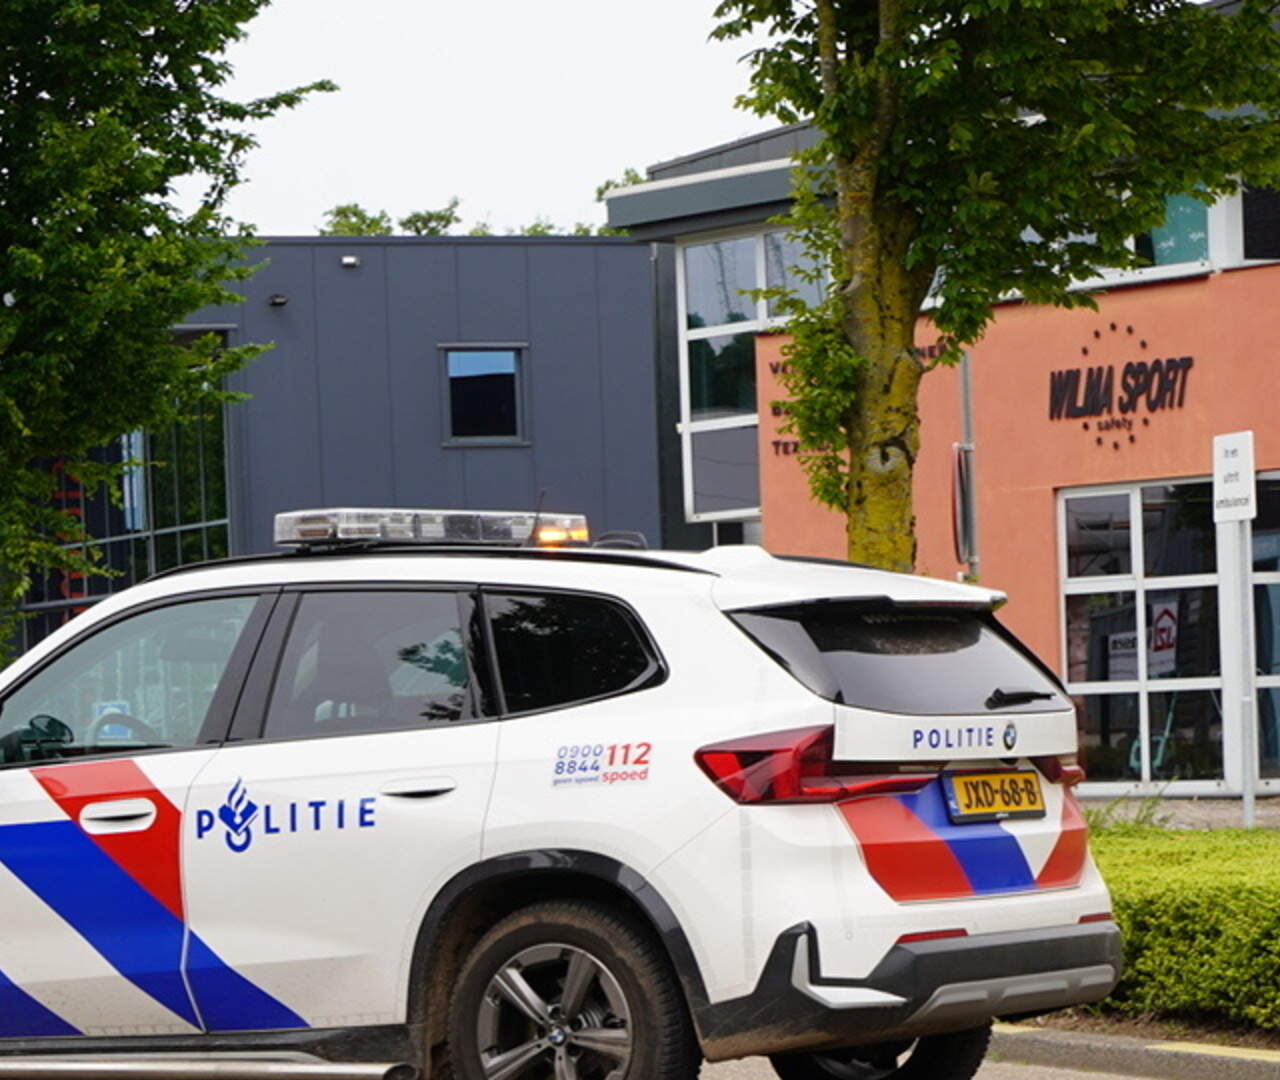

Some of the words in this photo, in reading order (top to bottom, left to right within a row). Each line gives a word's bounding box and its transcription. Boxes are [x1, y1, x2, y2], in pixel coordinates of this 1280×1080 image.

[1049, 364, 1115, 421] WILMA
[1118, 356, 1194, 415] SPORT
[913, 727, 994, 749] POLITIE
[557, 744, 603, 759] 0900
[607, 742, 652, 766] 112
[554, 760, 600, 775] 8844
[602, 767, 649, 784] spoed
[963, 778, 1038, 809] JXD-68-B
